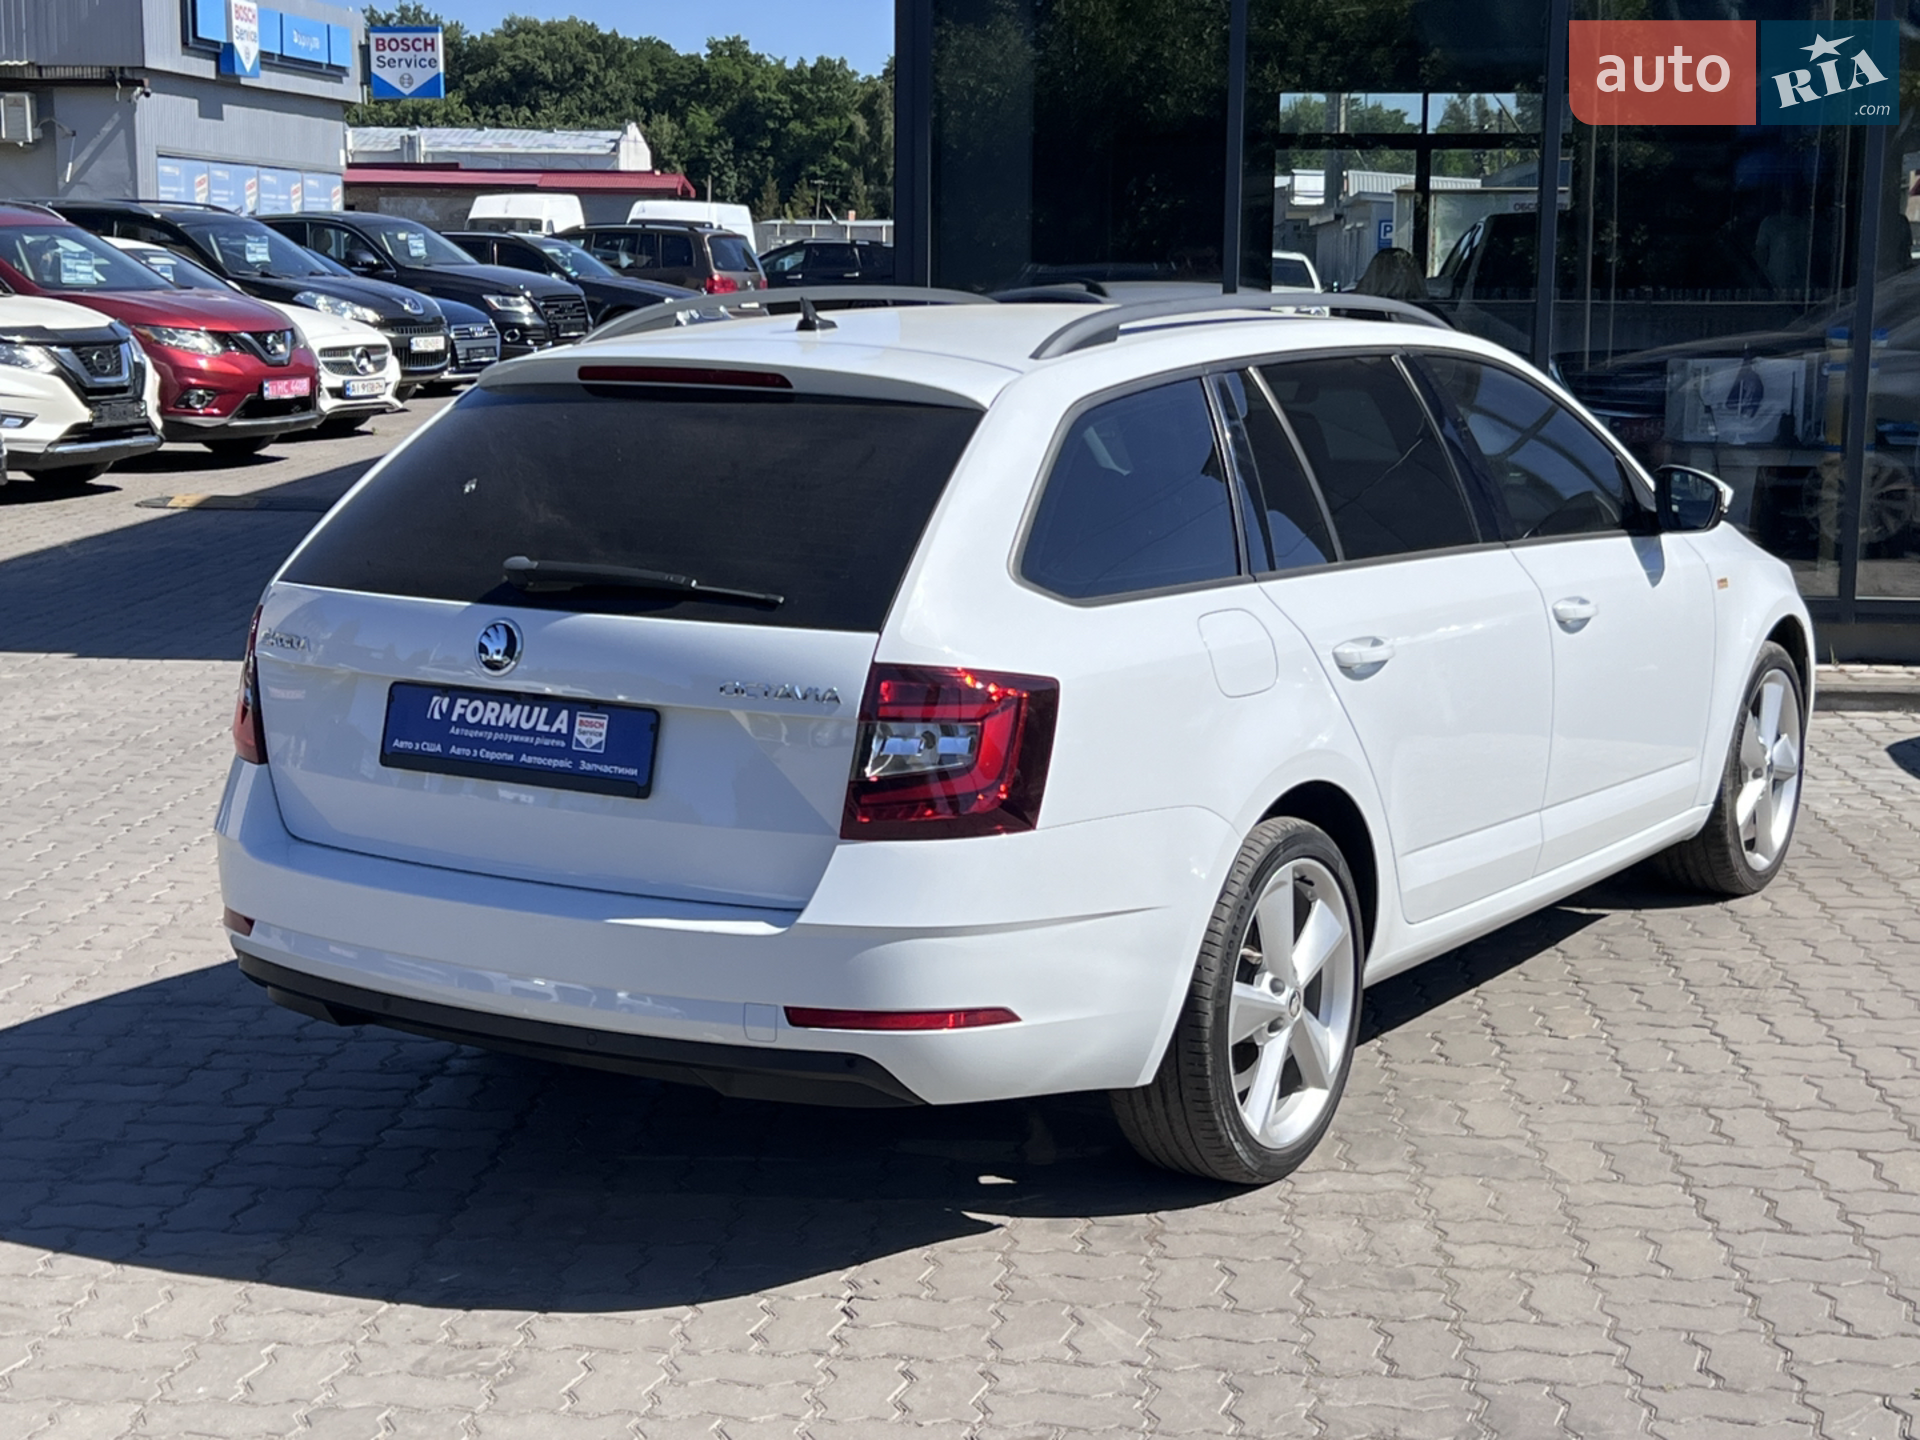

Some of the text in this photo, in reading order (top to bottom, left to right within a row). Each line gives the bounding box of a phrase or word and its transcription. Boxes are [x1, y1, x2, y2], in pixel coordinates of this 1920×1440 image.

[375, 37, 436, 53] BOSCH
[376, 54, 438, 69] Service
[719, 681, 843, 705] OCTAVIA
[451, 698, 569, 734] FORMULA
[578, 718, 605, 730] BOSCH
[449, 725, 566, 748] Автоцентр розумних рішень
[577, 728, 603, 738] Service
[392, 738, 442, 753] Авто з США
[449, 745, 515, 762] Авто з Європи
[520, 753, 573, 769] Автосервіс
[579, 760, 638, 777] Запчастини
